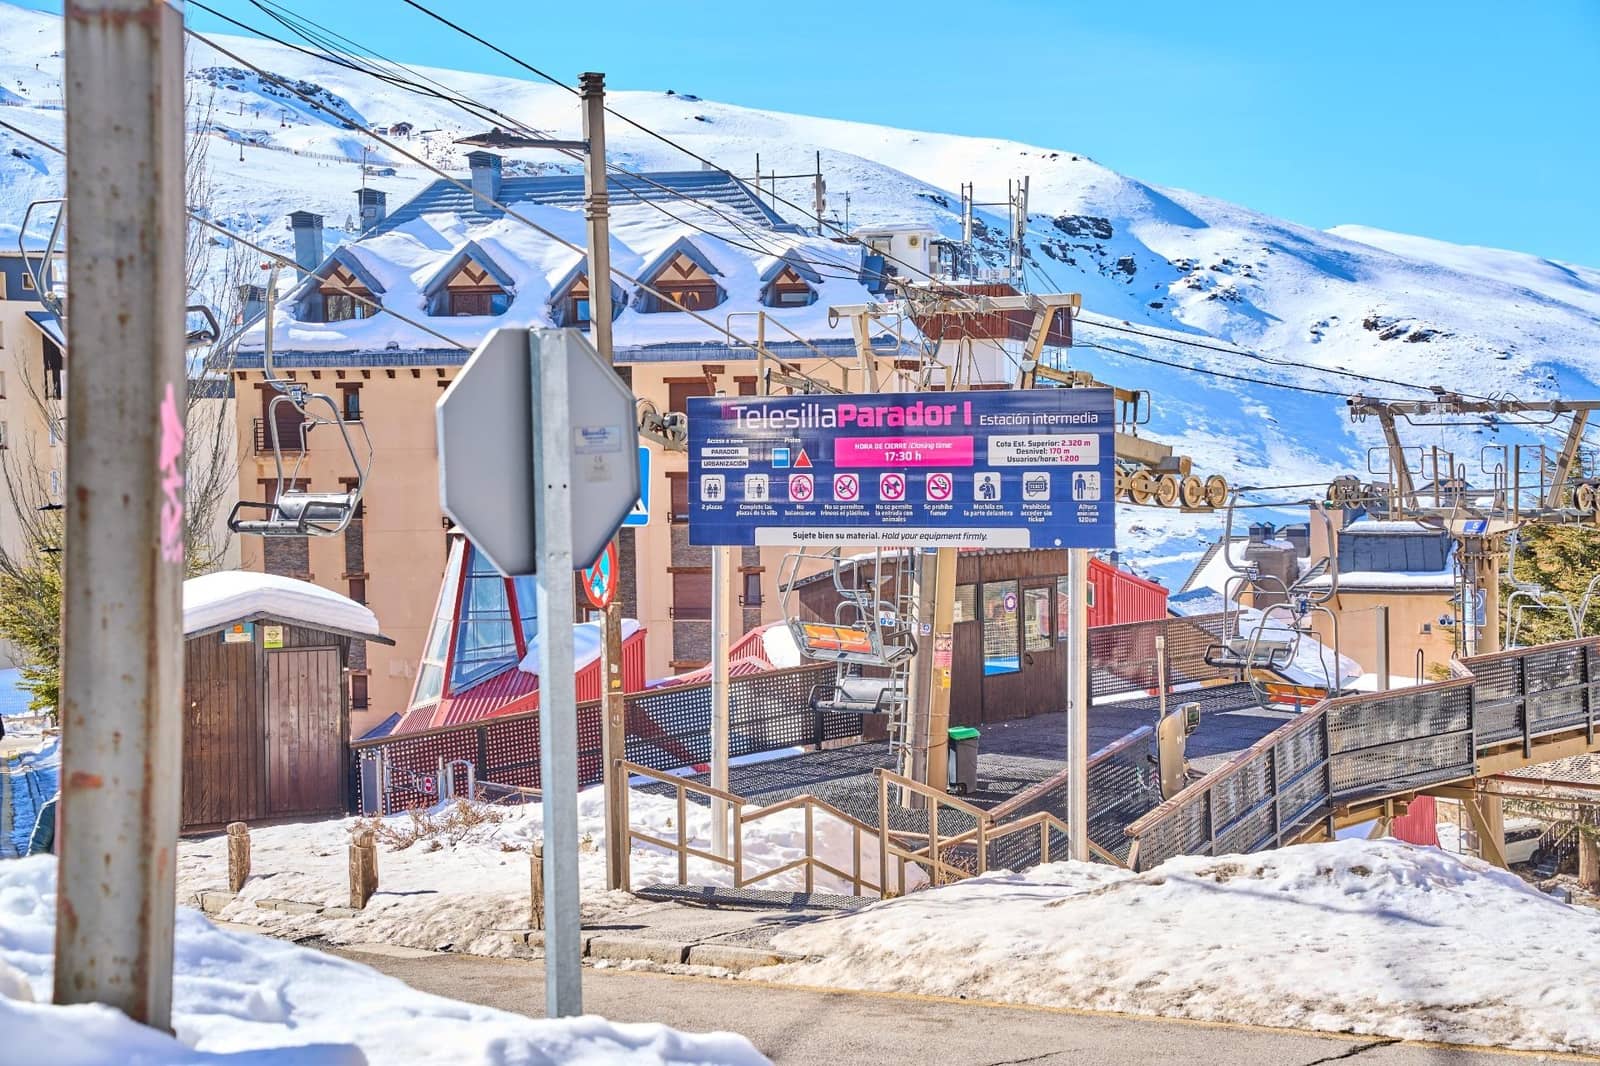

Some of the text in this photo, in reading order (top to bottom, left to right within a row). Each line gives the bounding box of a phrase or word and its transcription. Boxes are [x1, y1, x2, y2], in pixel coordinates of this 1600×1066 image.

[980, 412, 1098, 426] Estación intermedia
[1028, 440, 1060, 448] Superior:
[885, 451, 922, 461] 17:30 h
[793, 532, 817, 540] Sujete
[901, 533, 918, 541] your
[919, 532, 961, 541] equipment
[963, 532, 988, 541] firmly.
